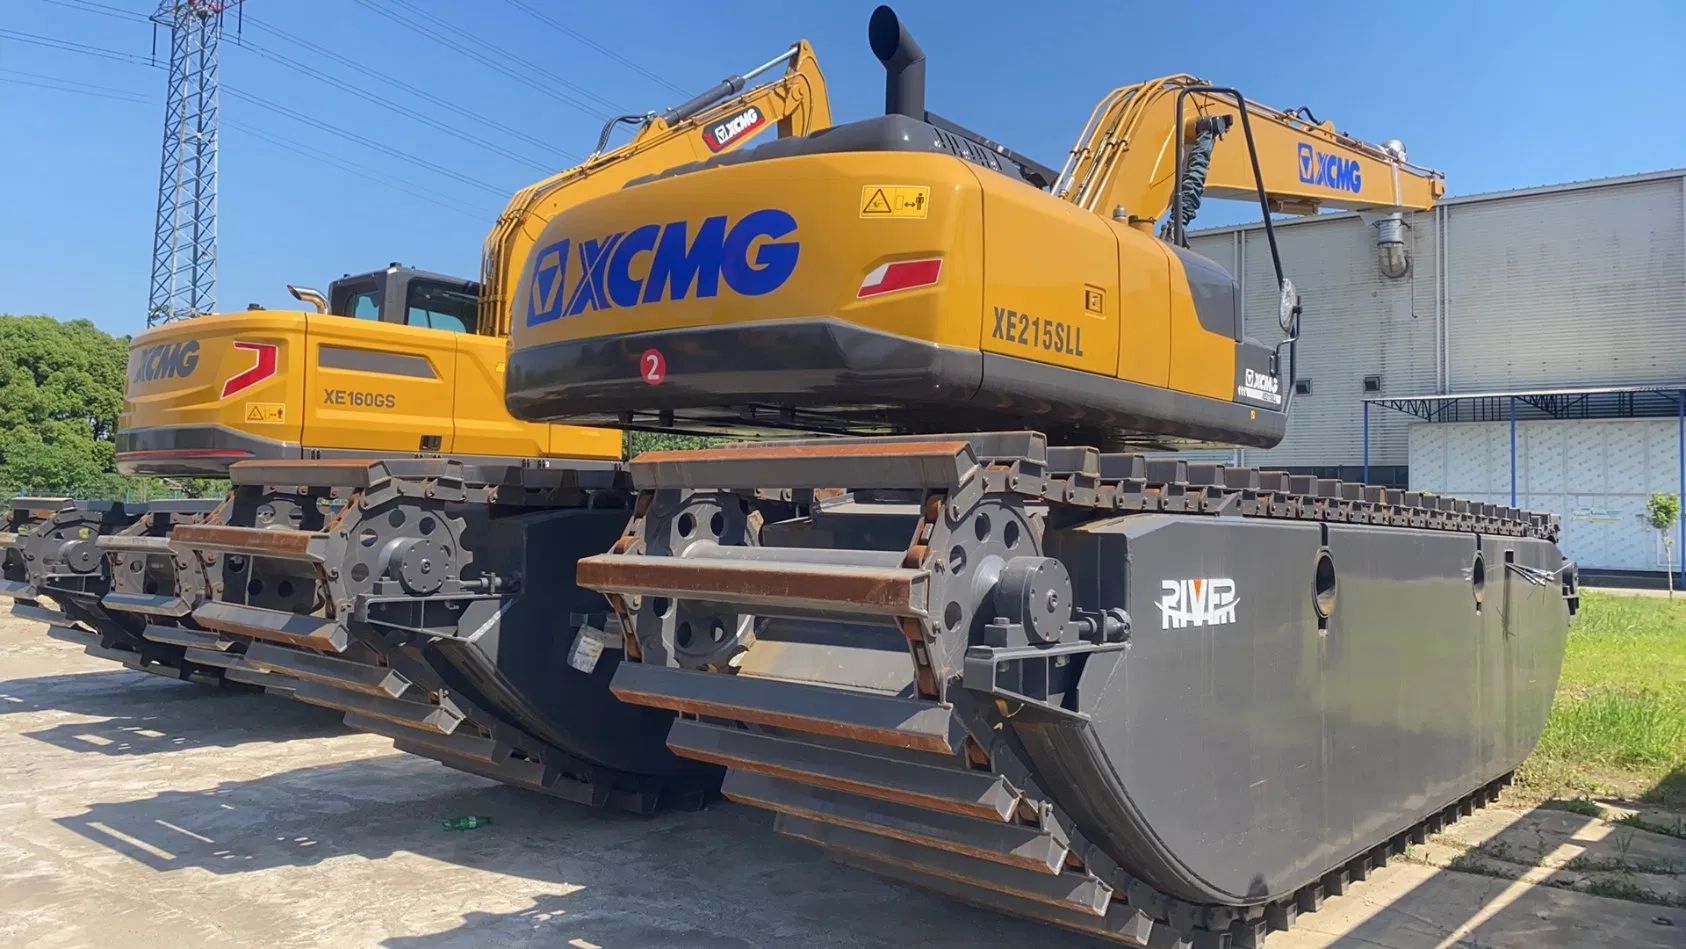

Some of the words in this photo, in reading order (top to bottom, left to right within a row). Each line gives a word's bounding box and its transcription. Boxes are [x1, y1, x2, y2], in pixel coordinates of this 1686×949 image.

[726, 108, 758, 137] XCMG
[1315, 151, 1362, 194] XCMG
[561, 209, 800, 317] XCMG
[992, 306, 1084, 357] XE215SLL
[134, 339, 201, 384] XCMG
[646, 354, 660, 380] 2
[323, 388, 396, 409] XE160GS
[1154, 577, 1240, 630] RIVER
